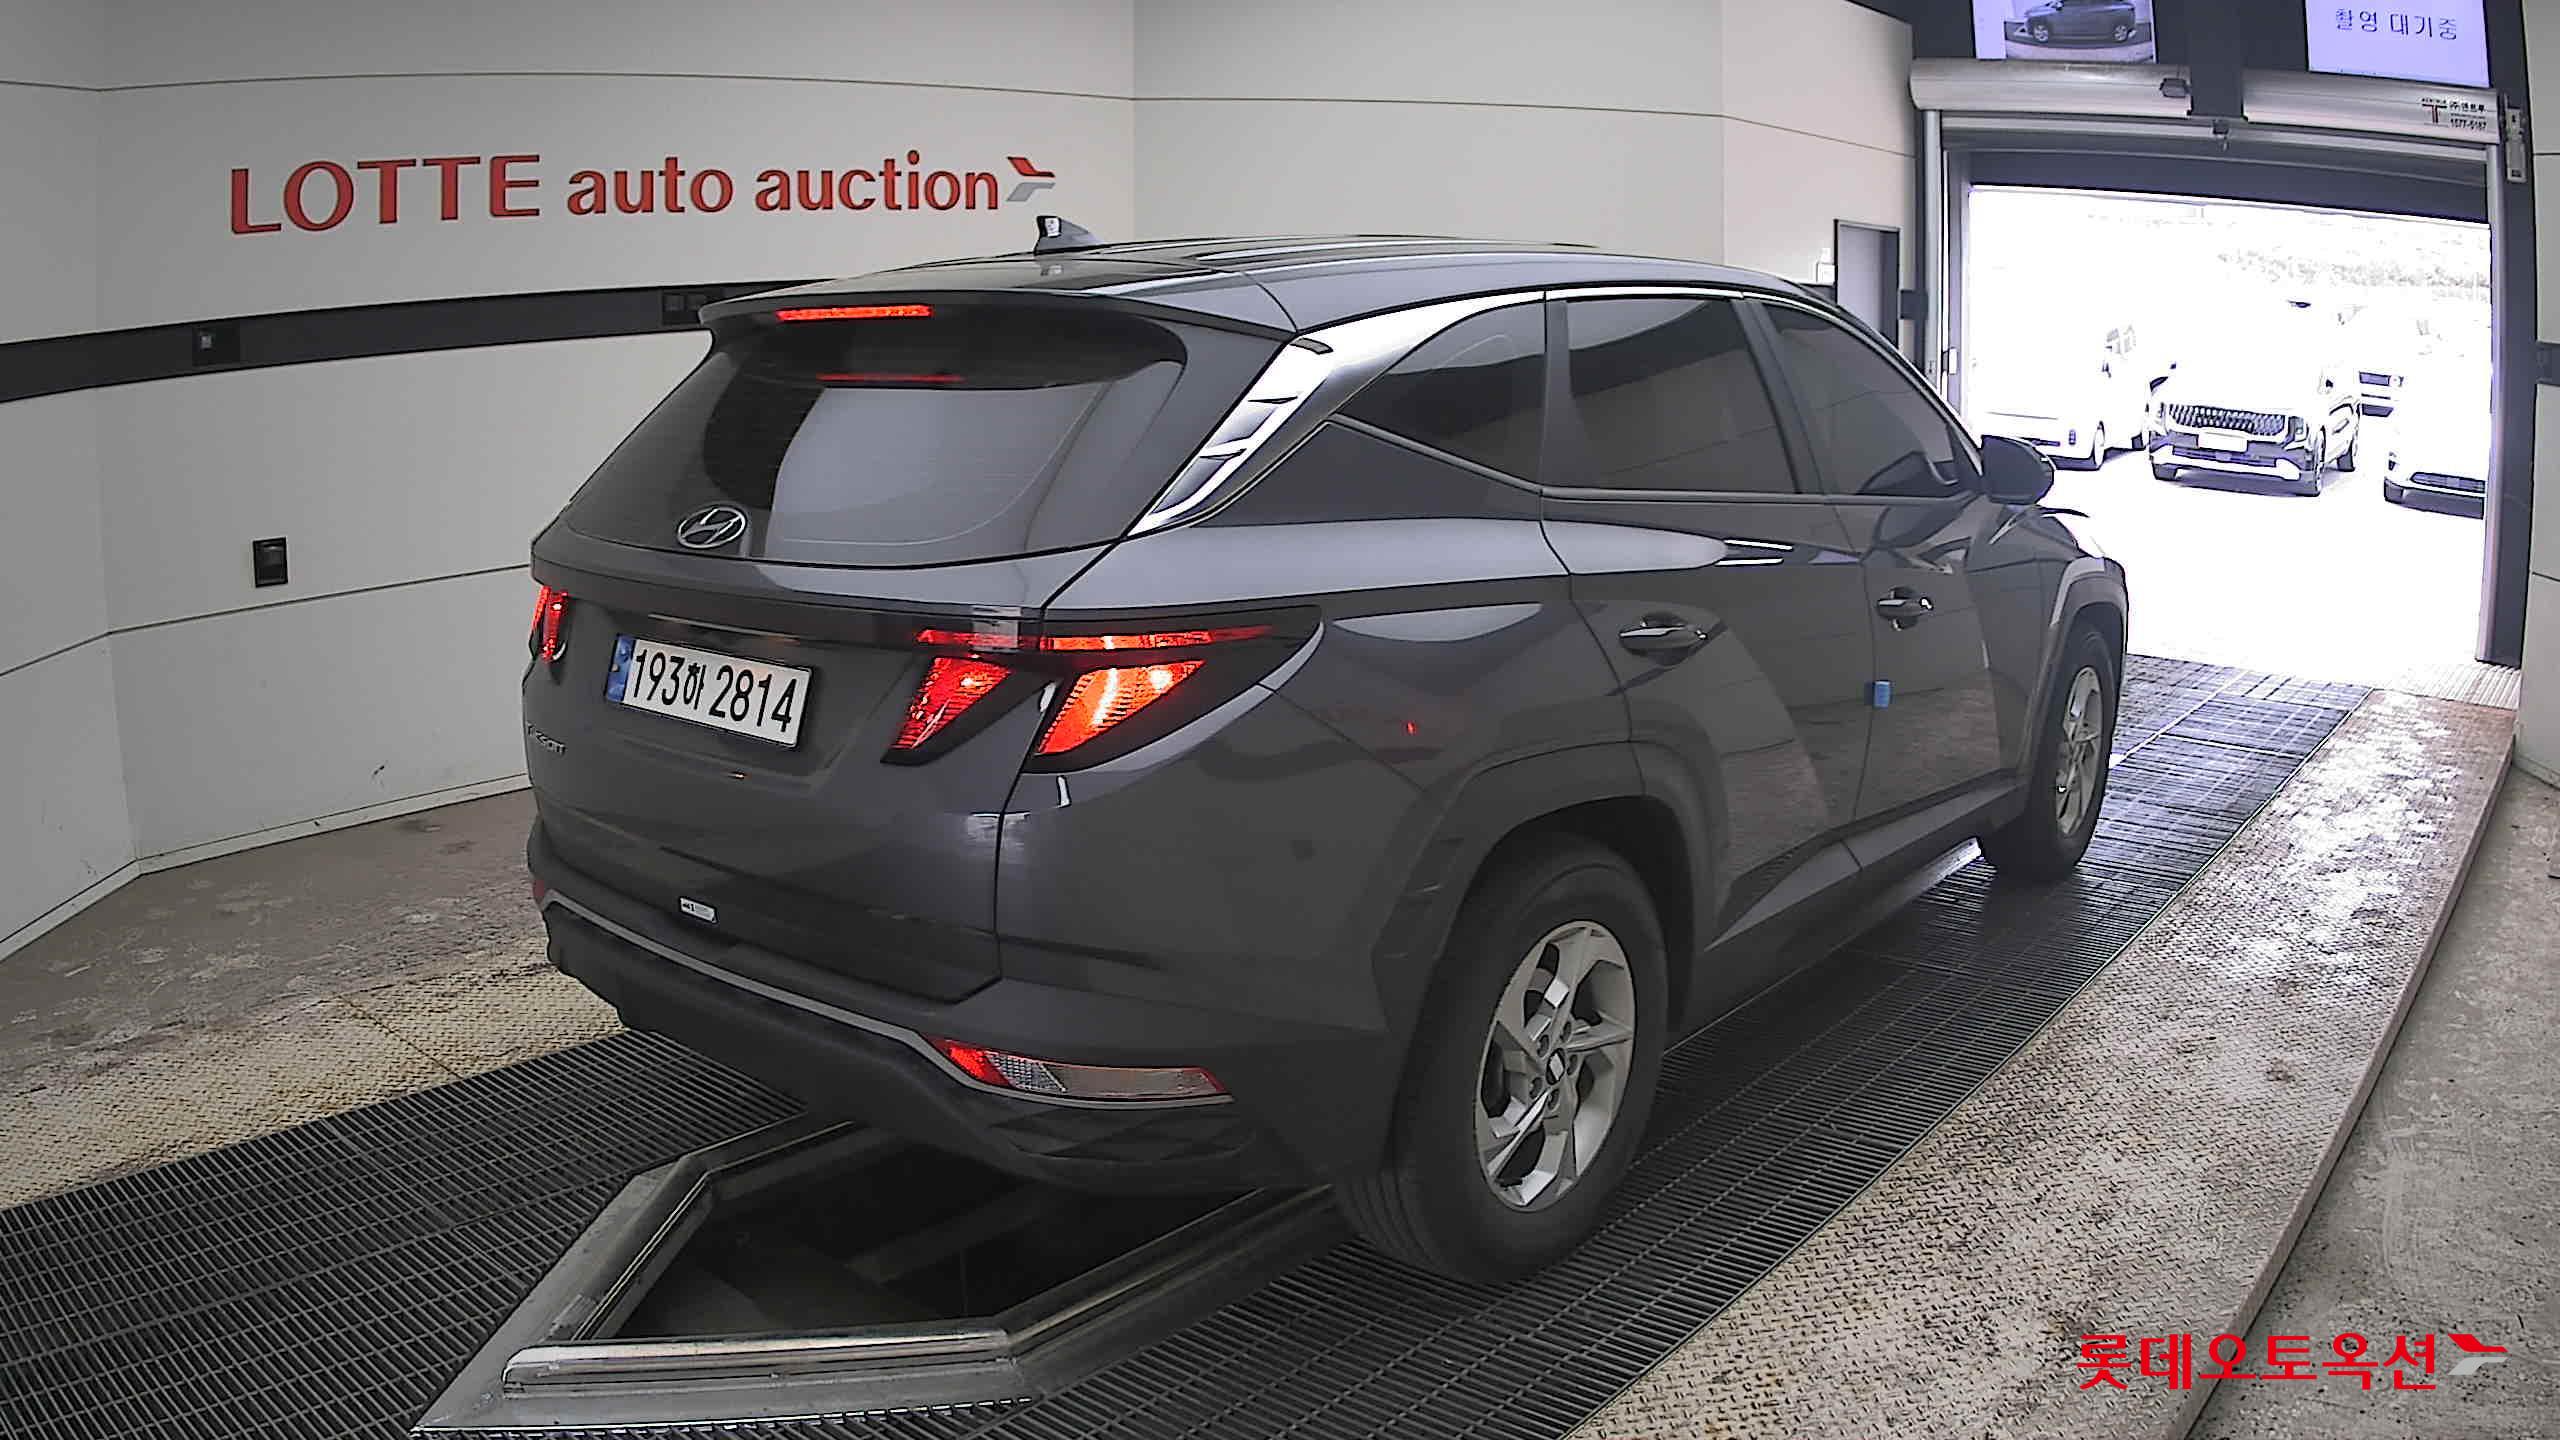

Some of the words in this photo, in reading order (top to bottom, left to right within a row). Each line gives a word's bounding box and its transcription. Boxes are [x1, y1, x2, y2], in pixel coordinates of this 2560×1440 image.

[2390, 13, 2457, 40] 대기중
[231, 153, 542, 235] LOTTE
[567, 156, 734, 215] auto
[755, 149, 1000, 211] auction
[633, 649, 706, 710] 193하
[708, 664, 798, 733] 2814
